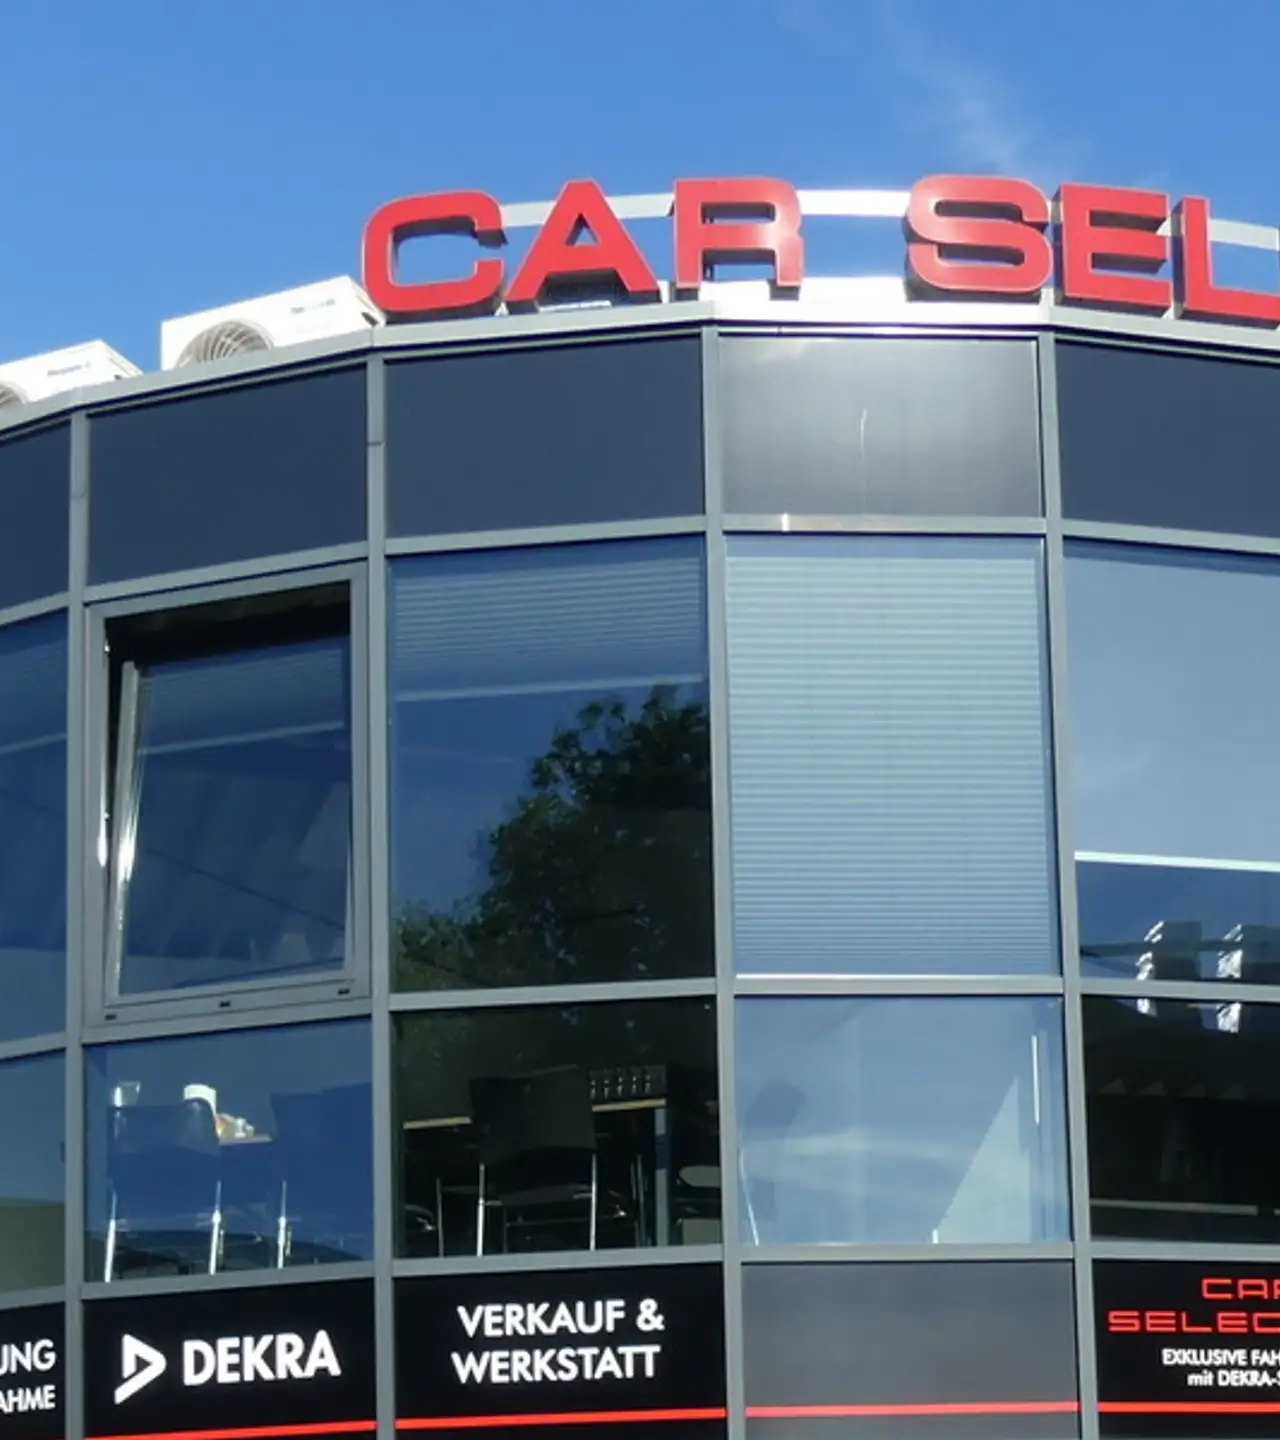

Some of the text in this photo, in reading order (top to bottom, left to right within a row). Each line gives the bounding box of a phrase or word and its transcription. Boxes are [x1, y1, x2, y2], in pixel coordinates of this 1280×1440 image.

[362, 175, 805, 316] CAR
[457, 1298, 665, 1338] VERKAUF &
[183, 1329, 342, 1386] DEKRA
[451, 1344, 661, 1384] WERKSTATT
[1161, 1347, 1247, 1367] EXKLUSIVE
[1187, 1370, 1214, 1386] mit
